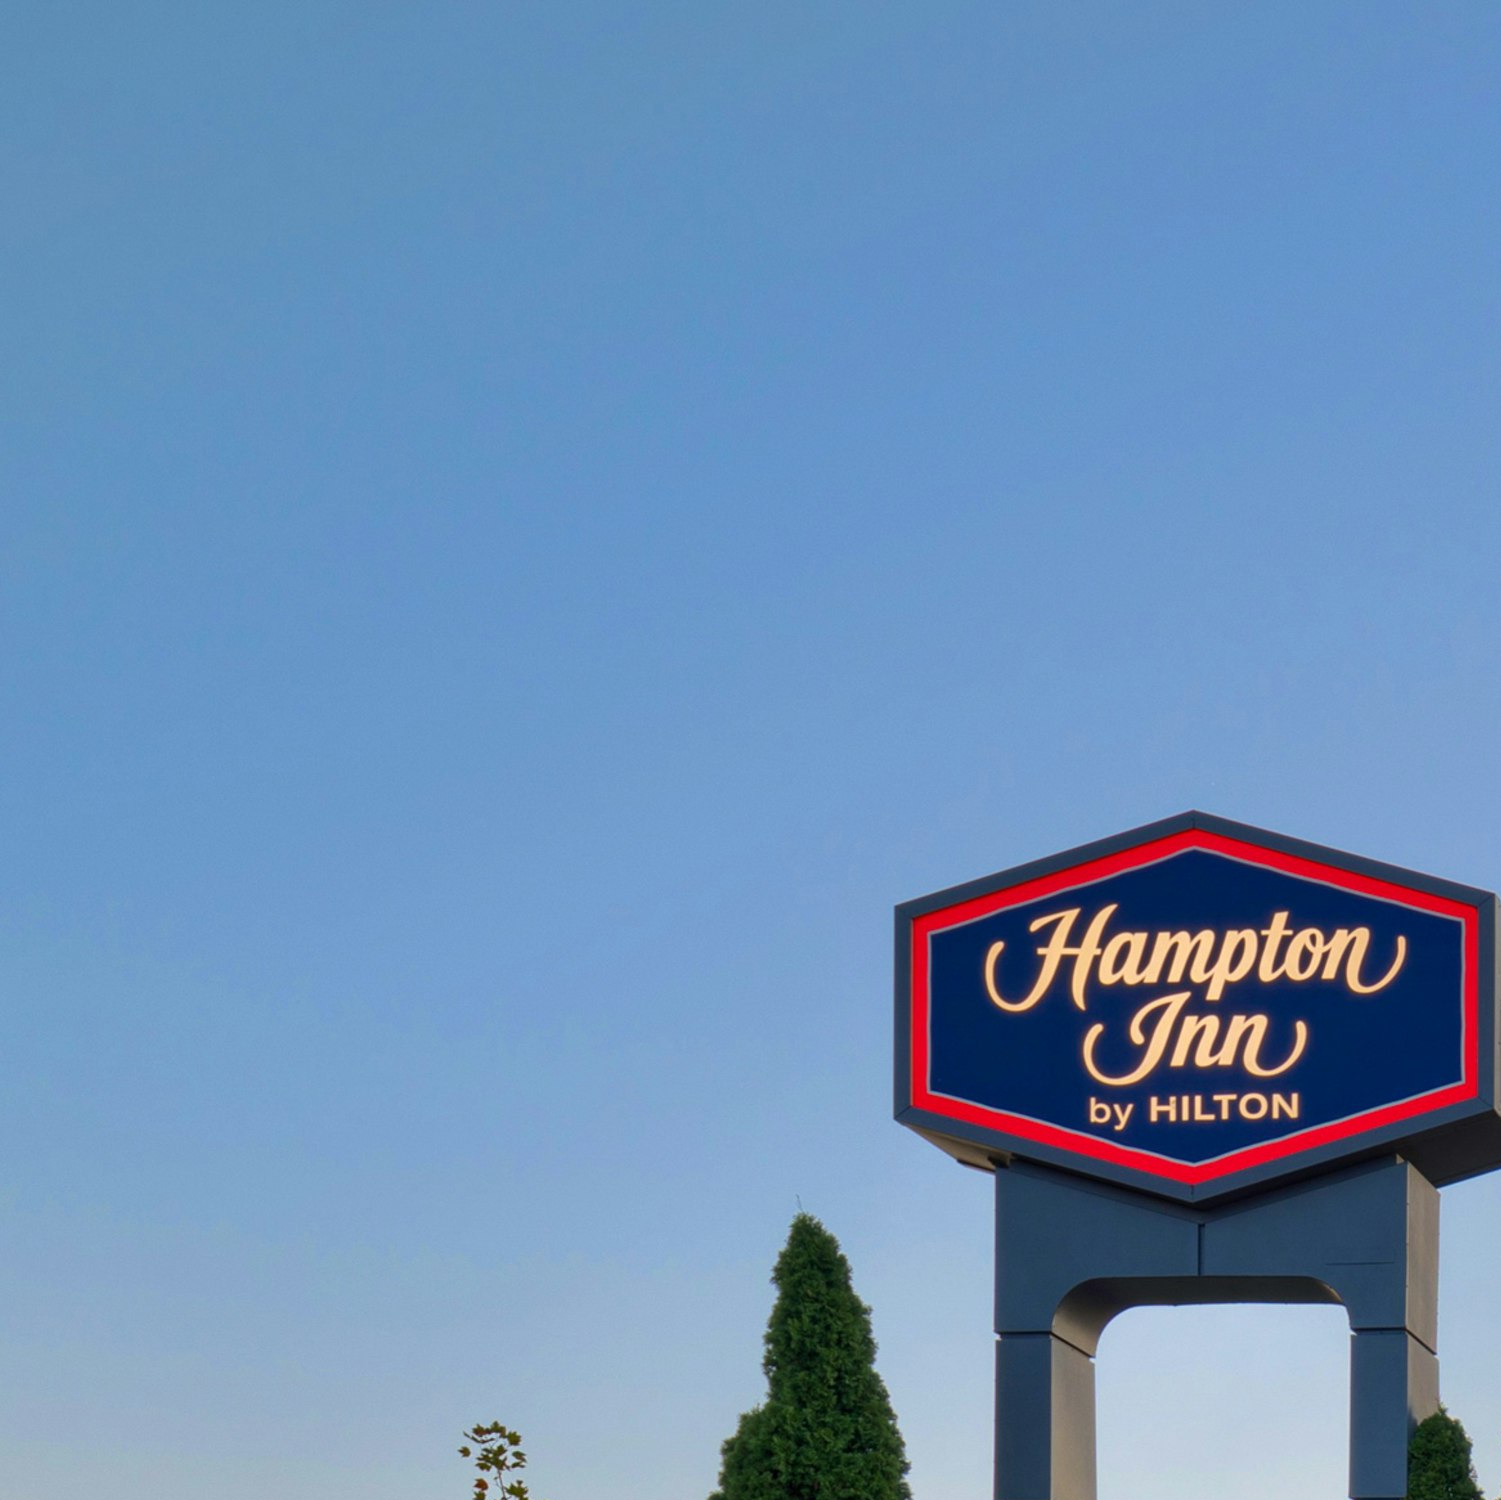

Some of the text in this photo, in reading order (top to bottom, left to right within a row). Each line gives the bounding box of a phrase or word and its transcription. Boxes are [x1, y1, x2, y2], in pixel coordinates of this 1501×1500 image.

[985, 903, 1406, 1012] Hampton
[1082, 991, 1308, 1086] Inn
[1089, 1092, 1300, 1131] by HILTON
